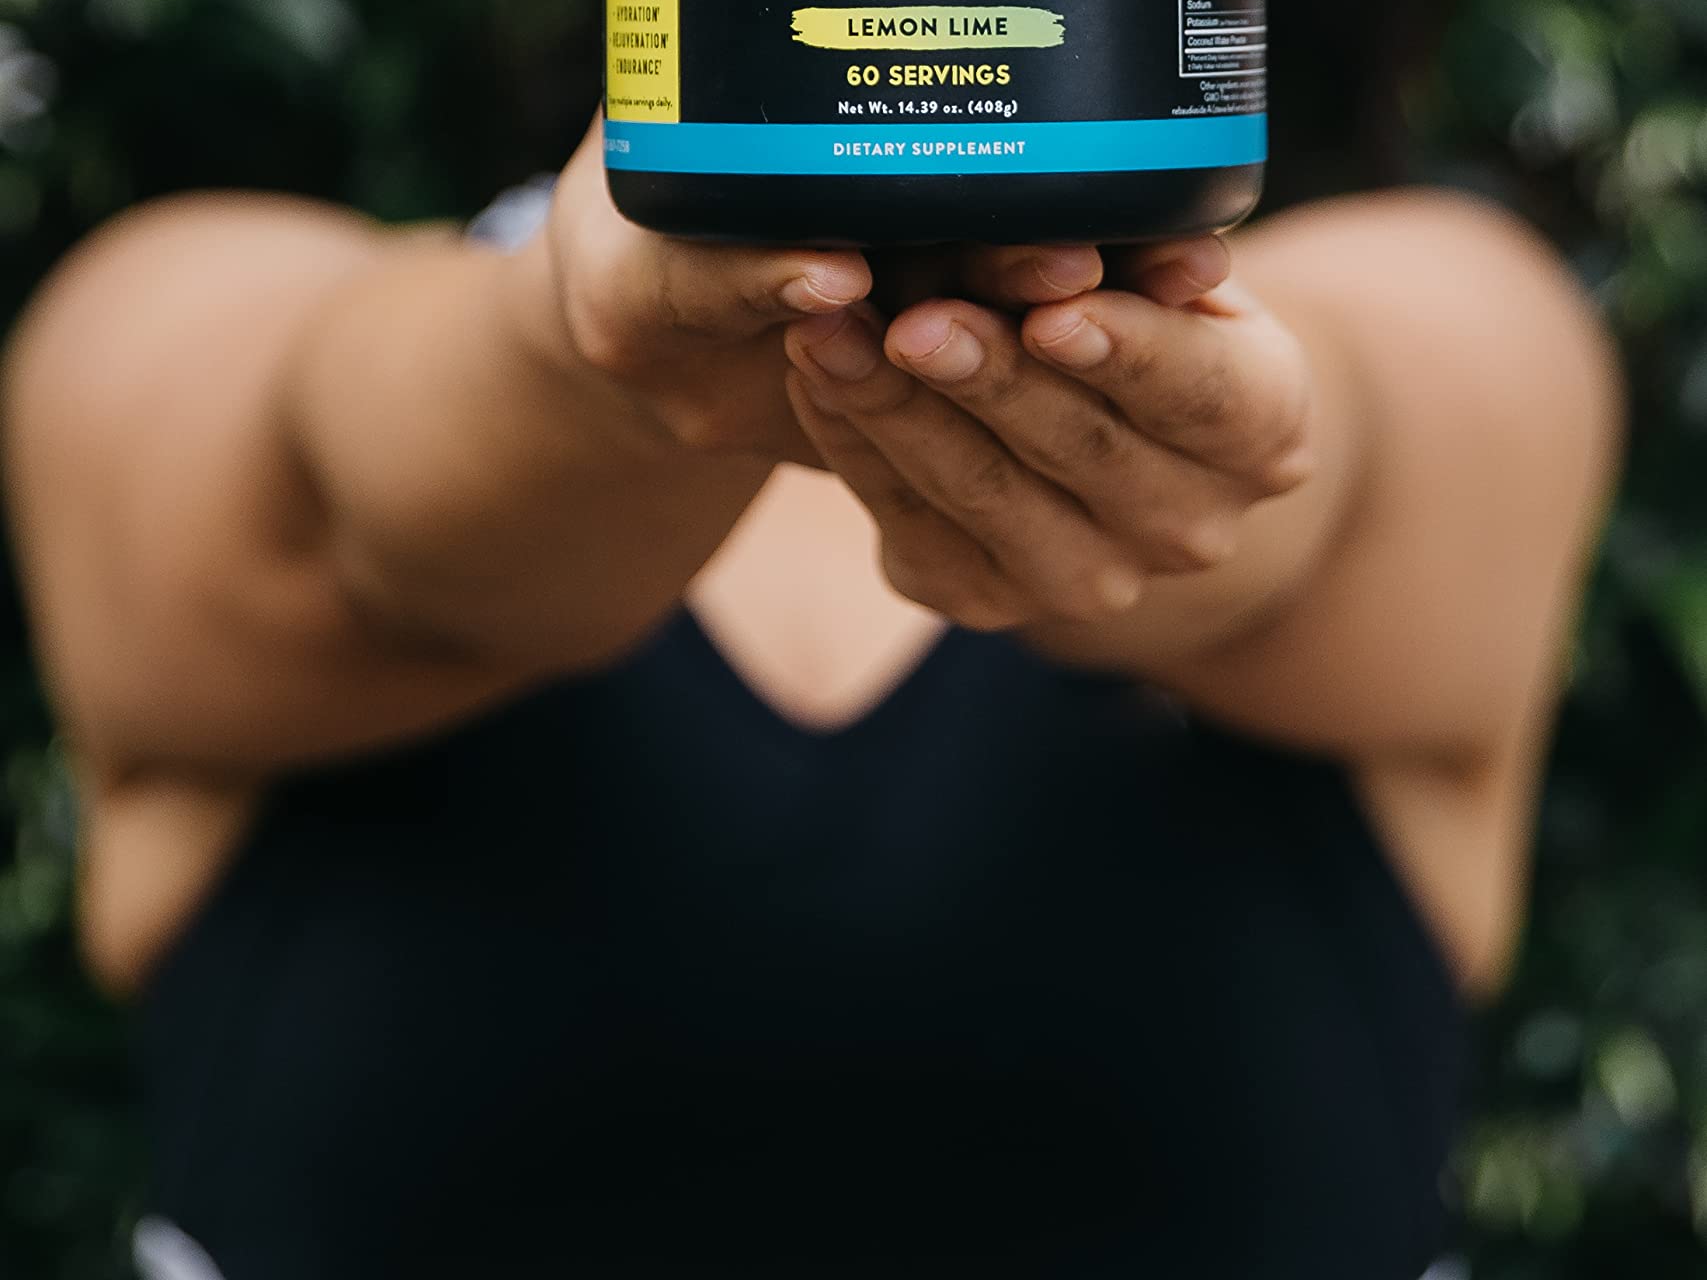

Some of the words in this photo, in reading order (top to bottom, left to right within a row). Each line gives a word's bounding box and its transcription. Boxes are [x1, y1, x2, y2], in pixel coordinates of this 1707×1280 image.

[1186, 0, 1212, 10] Sodium
[847, 17, 938, 37] LEMON
[949, 17, 1009, 36] LIME
[846, 65, 880, 86] 60
[888, 64, 1011, 86] SERVINGS
[837, 101, 863, 115] Net
[868, 100, 893, 115] Wt.
[897, 100, 938, 115] 14.39
[943, 104, 963, 115] oz.
[968, 99, 1018, 118] (408g)
[832, 142, 906, 157] DIETARY
[911, 141, 1026, 156] SUPPLEMENT
